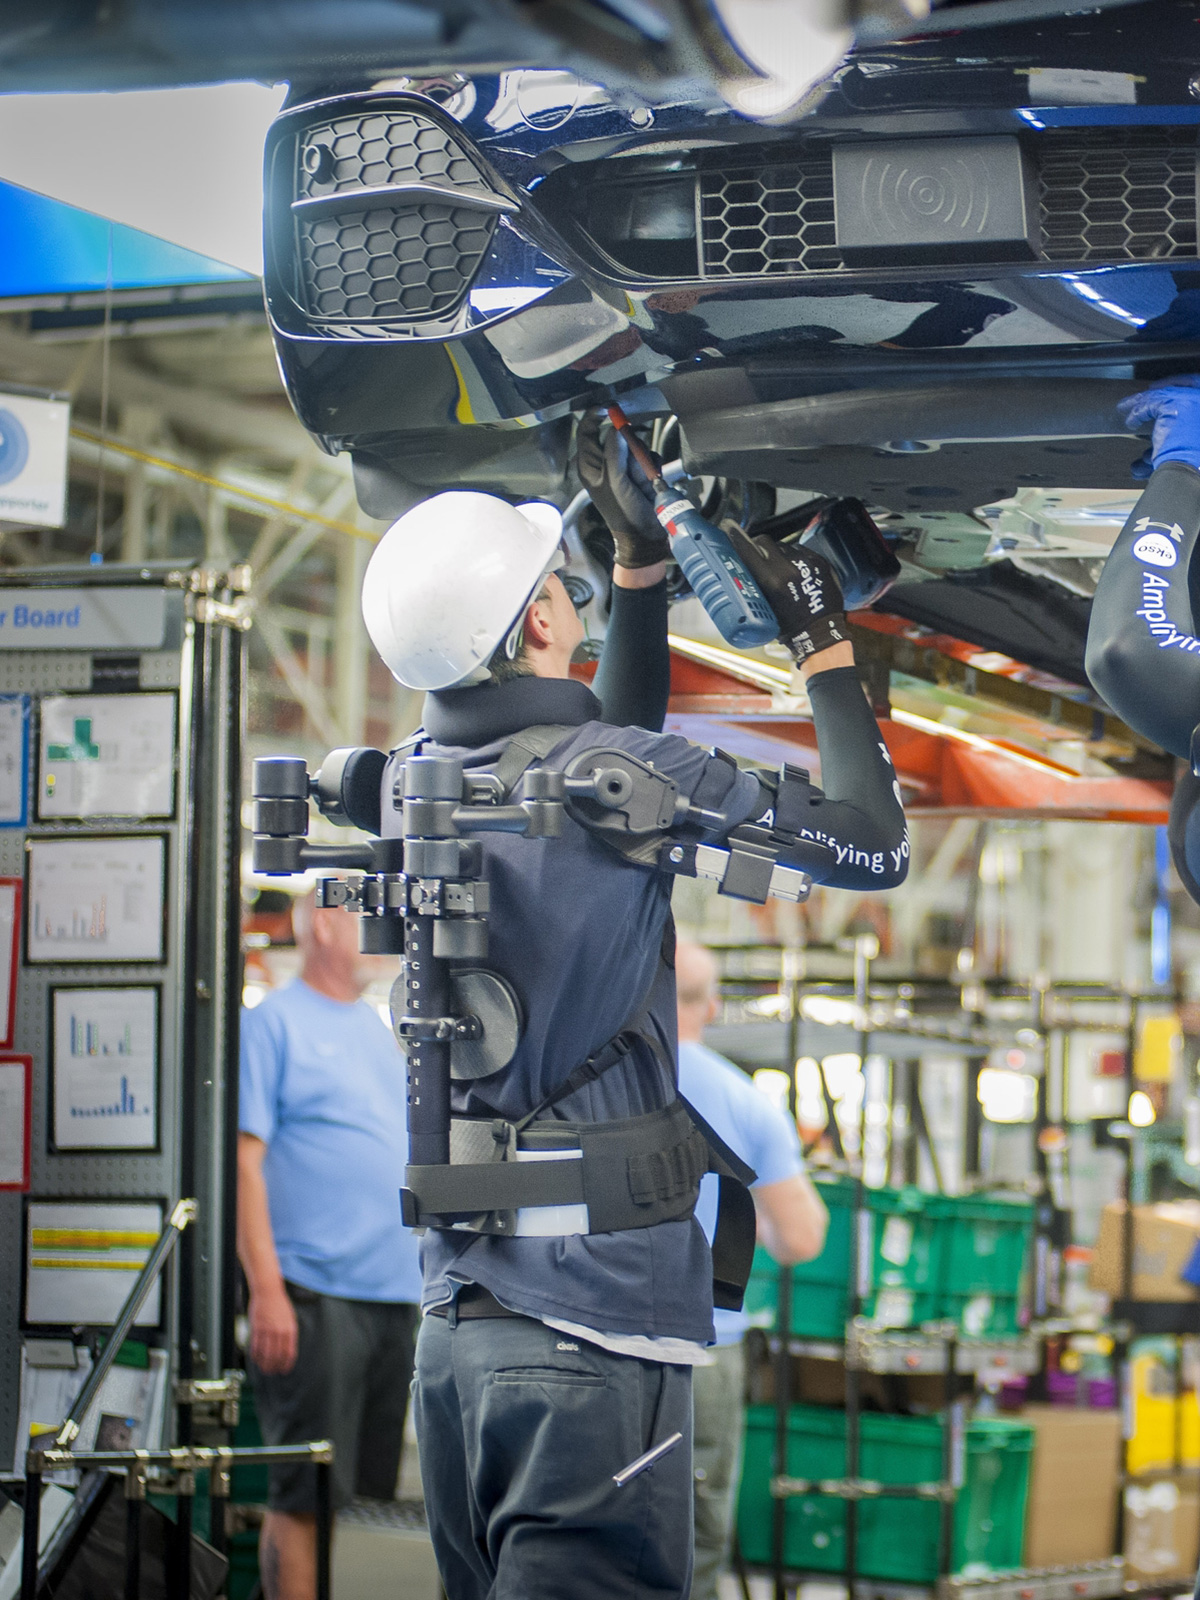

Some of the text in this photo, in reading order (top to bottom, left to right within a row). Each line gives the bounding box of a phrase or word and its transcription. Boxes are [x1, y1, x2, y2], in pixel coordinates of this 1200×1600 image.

[1138, 545, 1172, 560] ekso
[791, 559, 825, 614] HyFlex
[14, 604, 81, 628] Board
[411, 923, 419, 931] A
[411, 942, 419, 951] B
[411, 961, 420, 970] C
[411, 980, 420, 989] D
[412, 1000, 419, 1009] E
[413, 1057, 421, 1067] H
